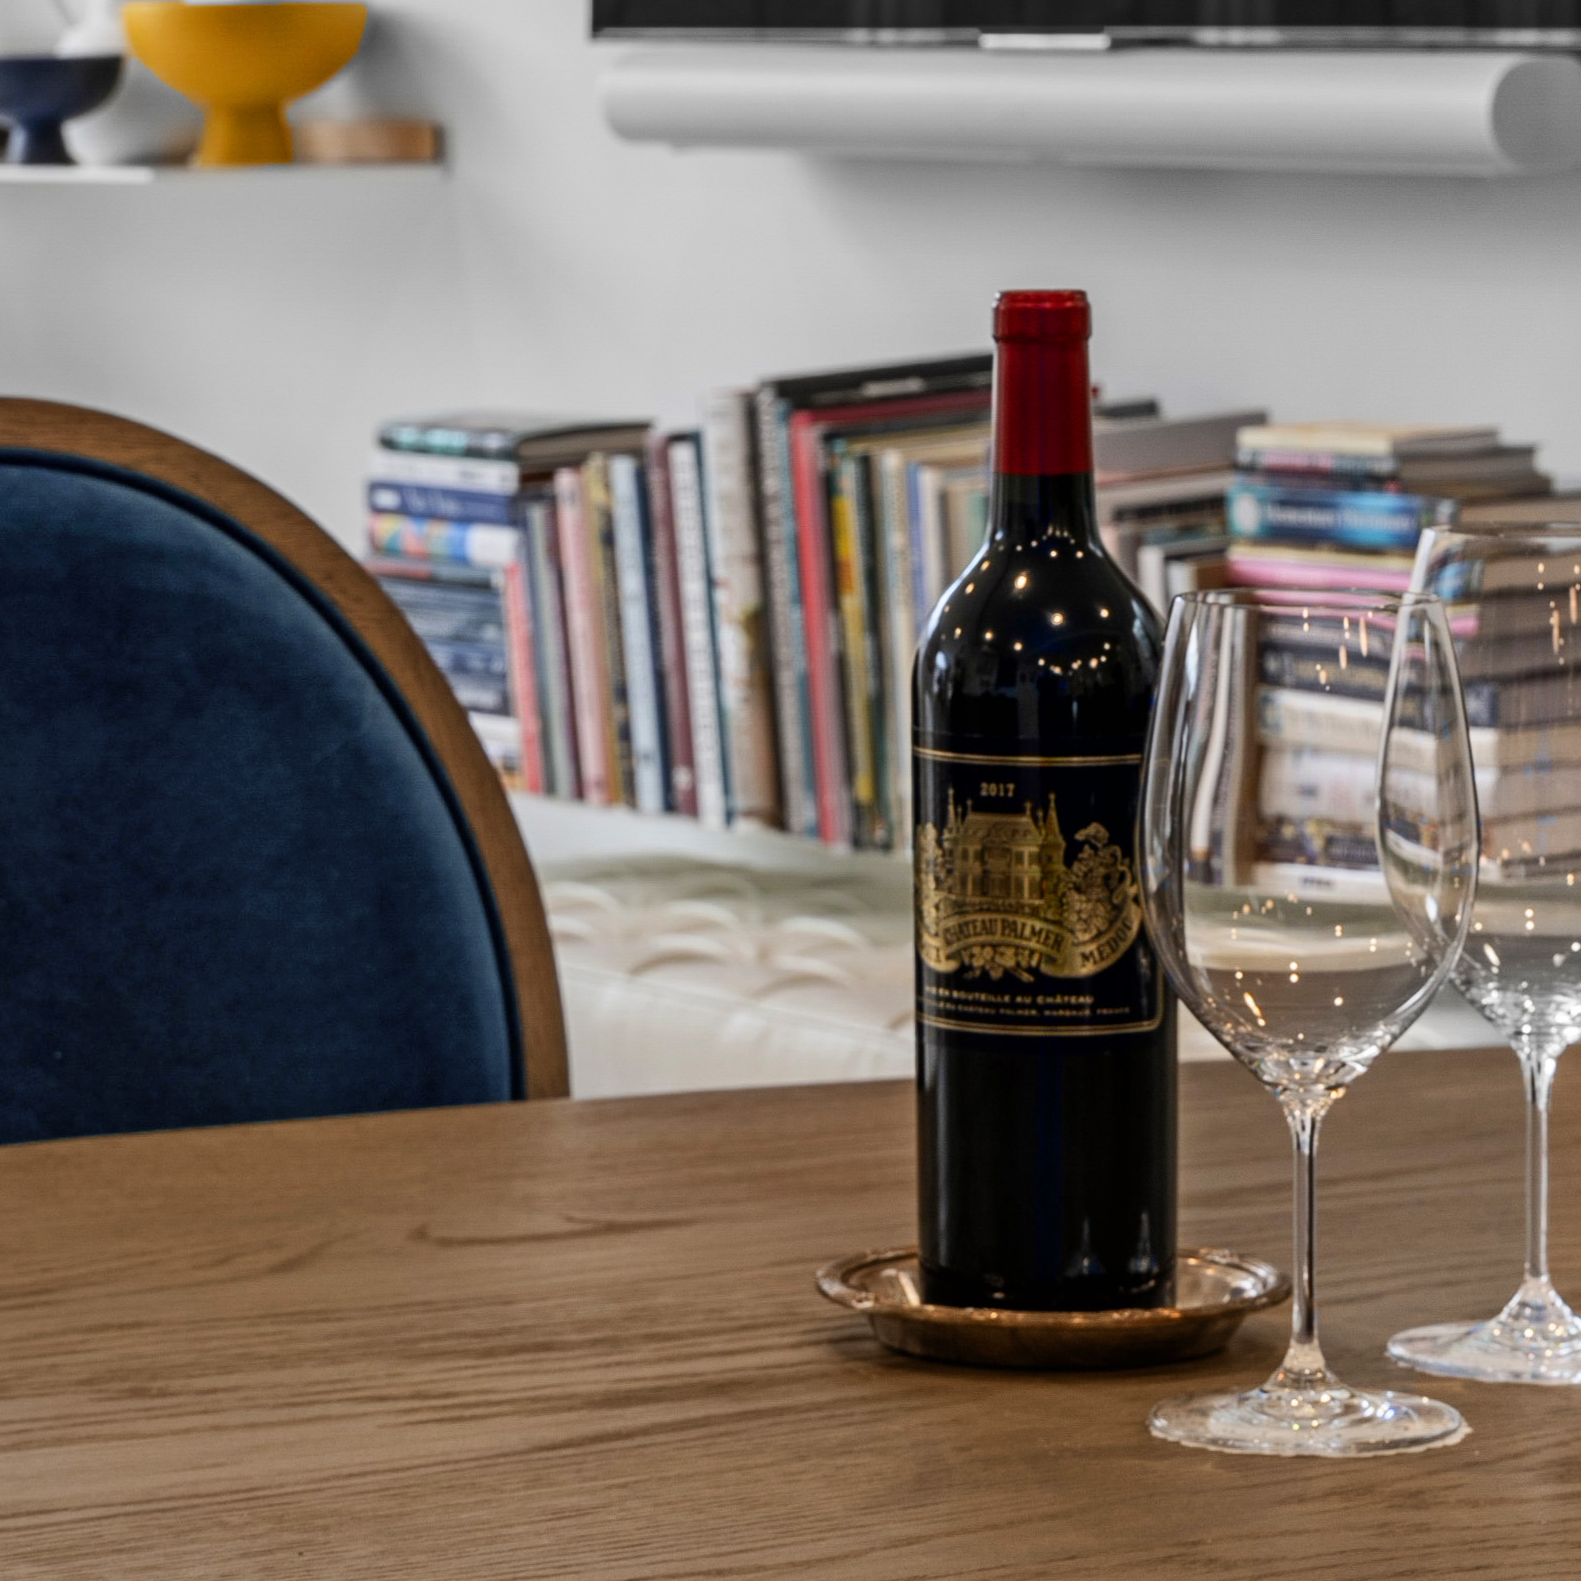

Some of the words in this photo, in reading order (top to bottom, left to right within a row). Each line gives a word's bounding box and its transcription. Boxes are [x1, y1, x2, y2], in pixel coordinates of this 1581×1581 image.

[980, 782, 1015, 797] 2017
[1000, 918, 1065, 952] PALMER
[952, 990, 1011, 1004] BOUTEILLE
[1015, 995, 1031, 1004] AU
